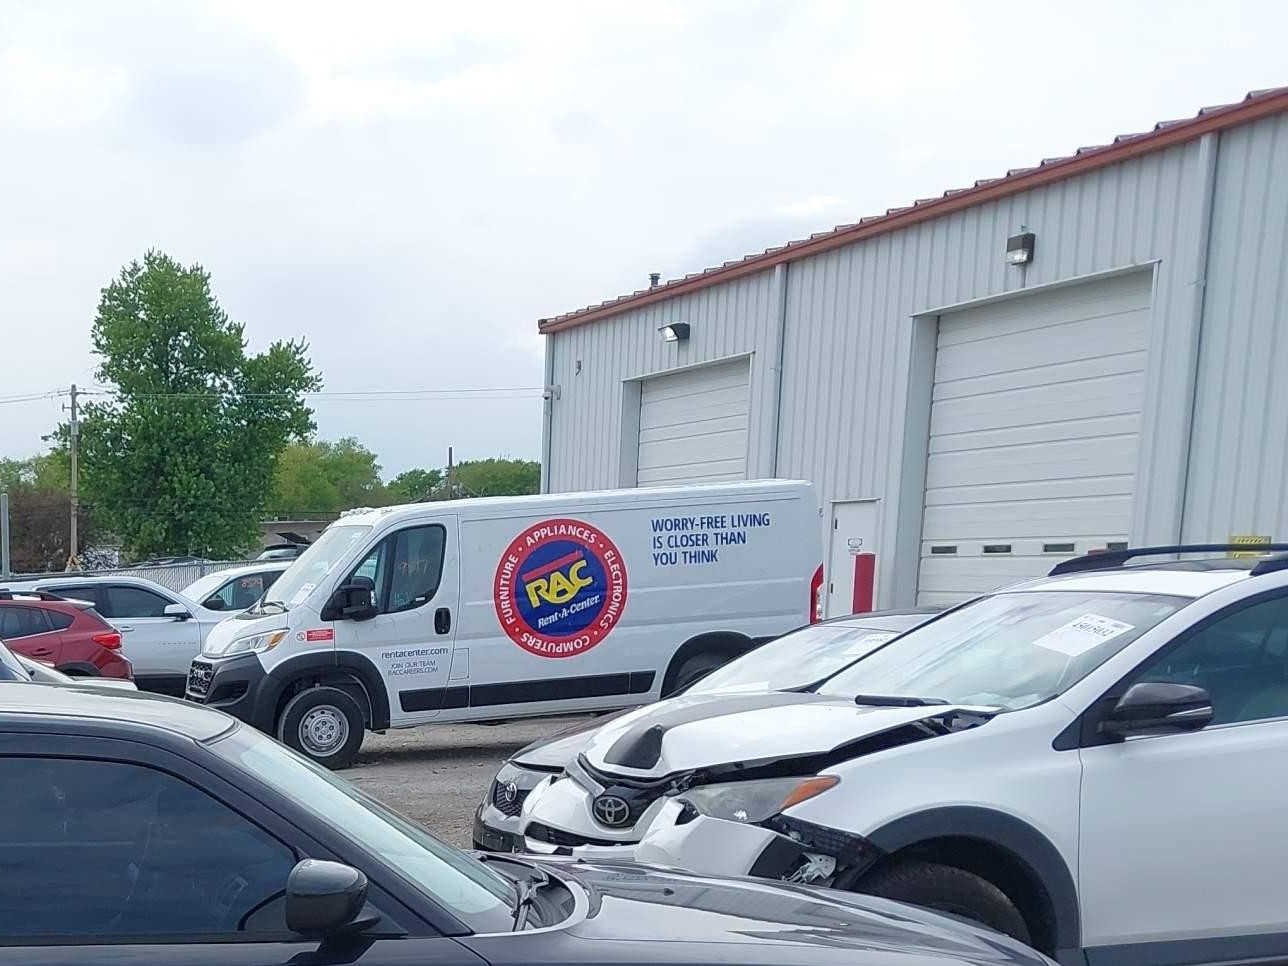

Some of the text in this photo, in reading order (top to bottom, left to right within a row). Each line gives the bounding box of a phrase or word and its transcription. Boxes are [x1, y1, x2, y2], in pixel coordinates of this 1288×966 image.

[651, 513, 770, 532] WORRY-FREE LIVING
[526, 525, 597, 546] APPLIANCES
[653, 531, 746, 549] IS CLOSER THAN
[653, 549, 718, 566] YOU THINK
[499, 554, 518, 625] FURNITURE
[525, 559, 593, 608] RAC
[599, 550, 622, 629] ELECTRONICS
[520, 632, 590, 653] COMPUTERS
[381, 648, 448, 659] rentacenter.com
